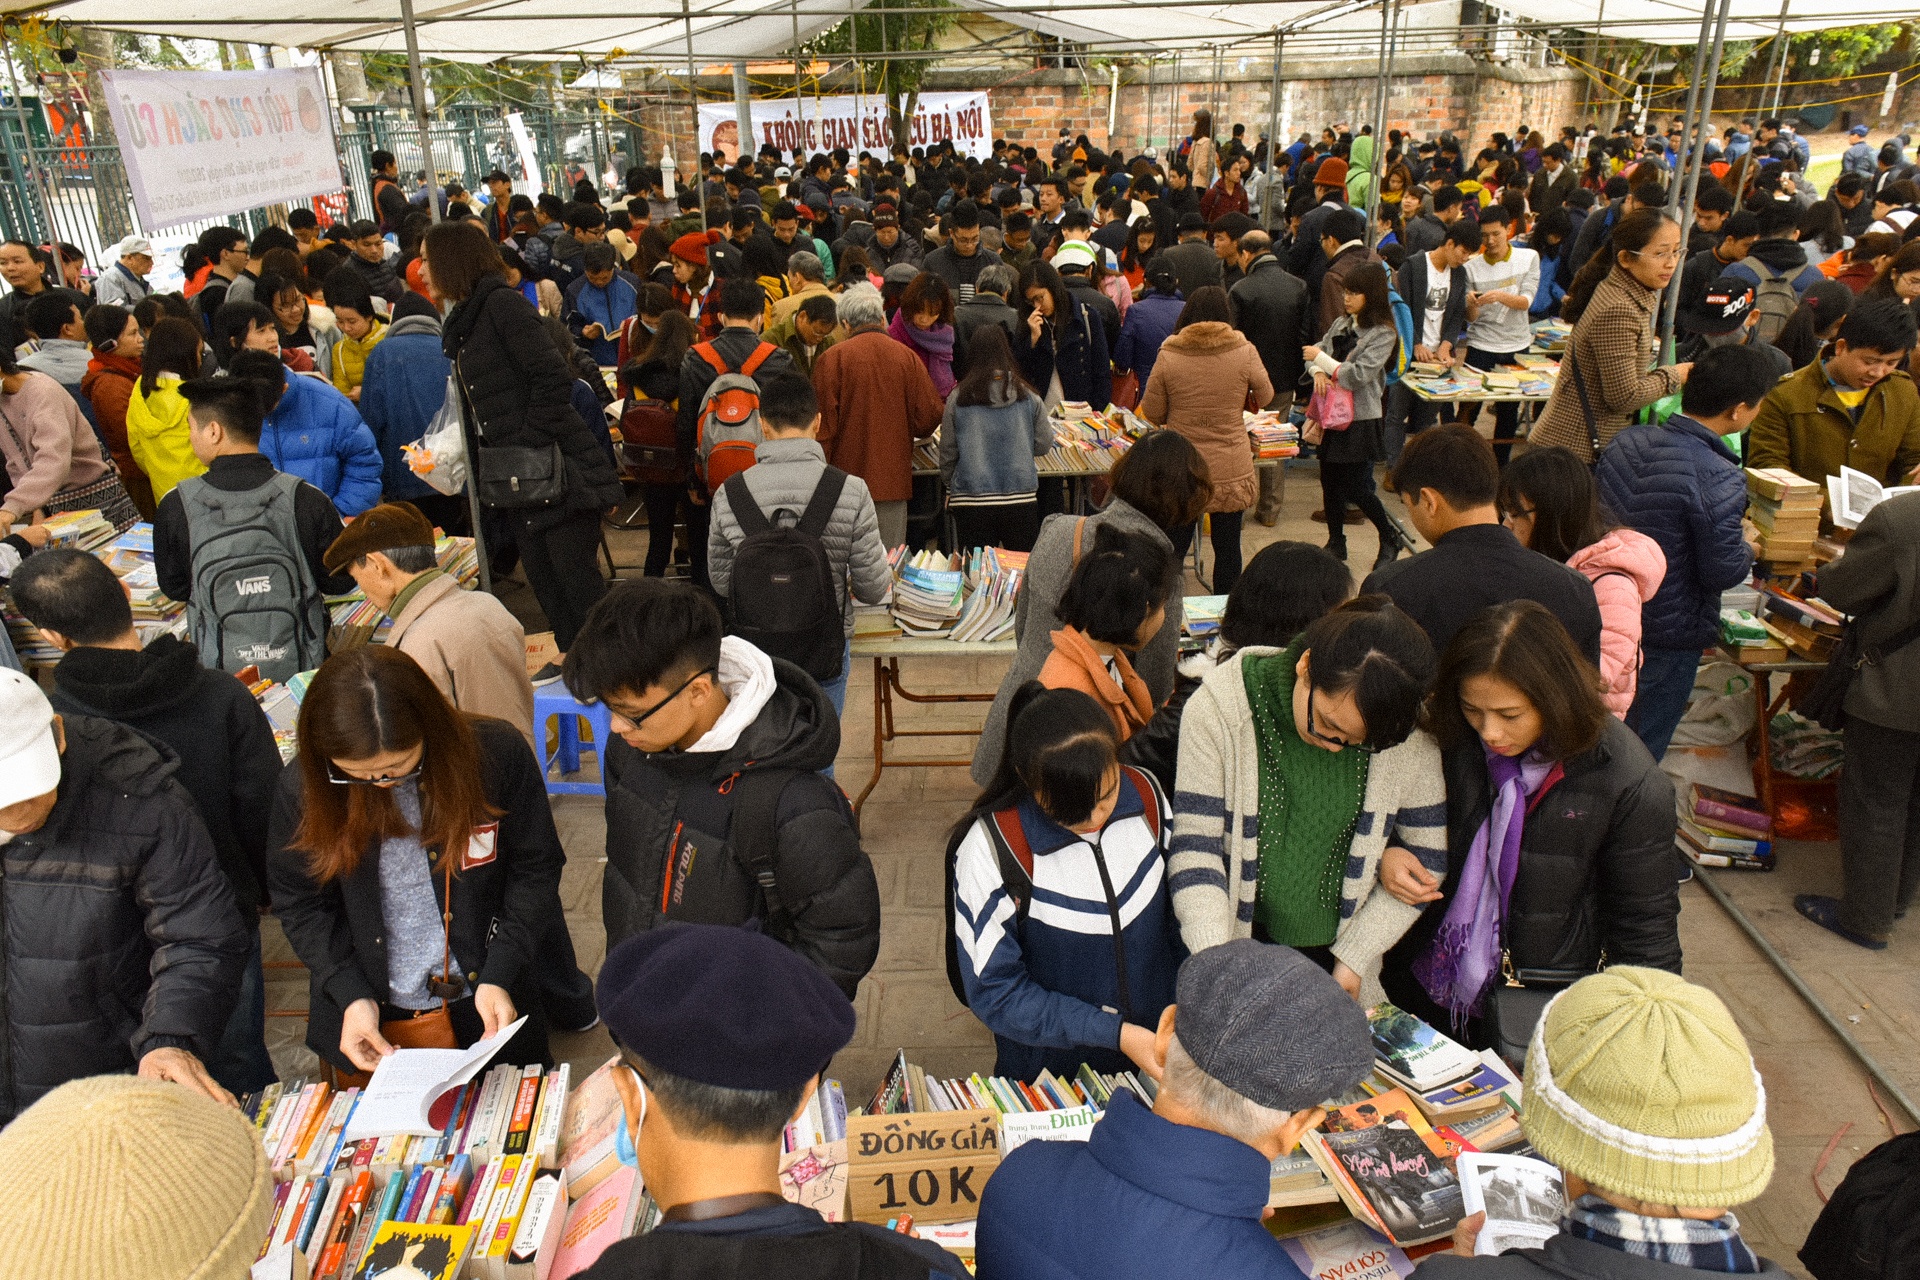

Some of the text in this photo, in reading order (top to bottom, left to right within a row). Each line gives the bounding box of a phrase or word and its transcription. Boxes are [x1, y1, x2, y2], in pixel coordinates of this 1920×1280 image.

[763, 110, 817, 152] KHÔNG
[822, 117, 857, 151] GIAN
[863, 107, 893, 148] SÁC
[932, 100, 953, 143] HÀ
[956, 100, 984, 148] NỘI
[235, 576, 271, 595] VANS
[1050, 1109, 1095, 1129] Đỉnh
[858, 1116, 997, 1157] ĐỒNG GIÁ
[1357, 1250, 1386, 1270] GỌI
